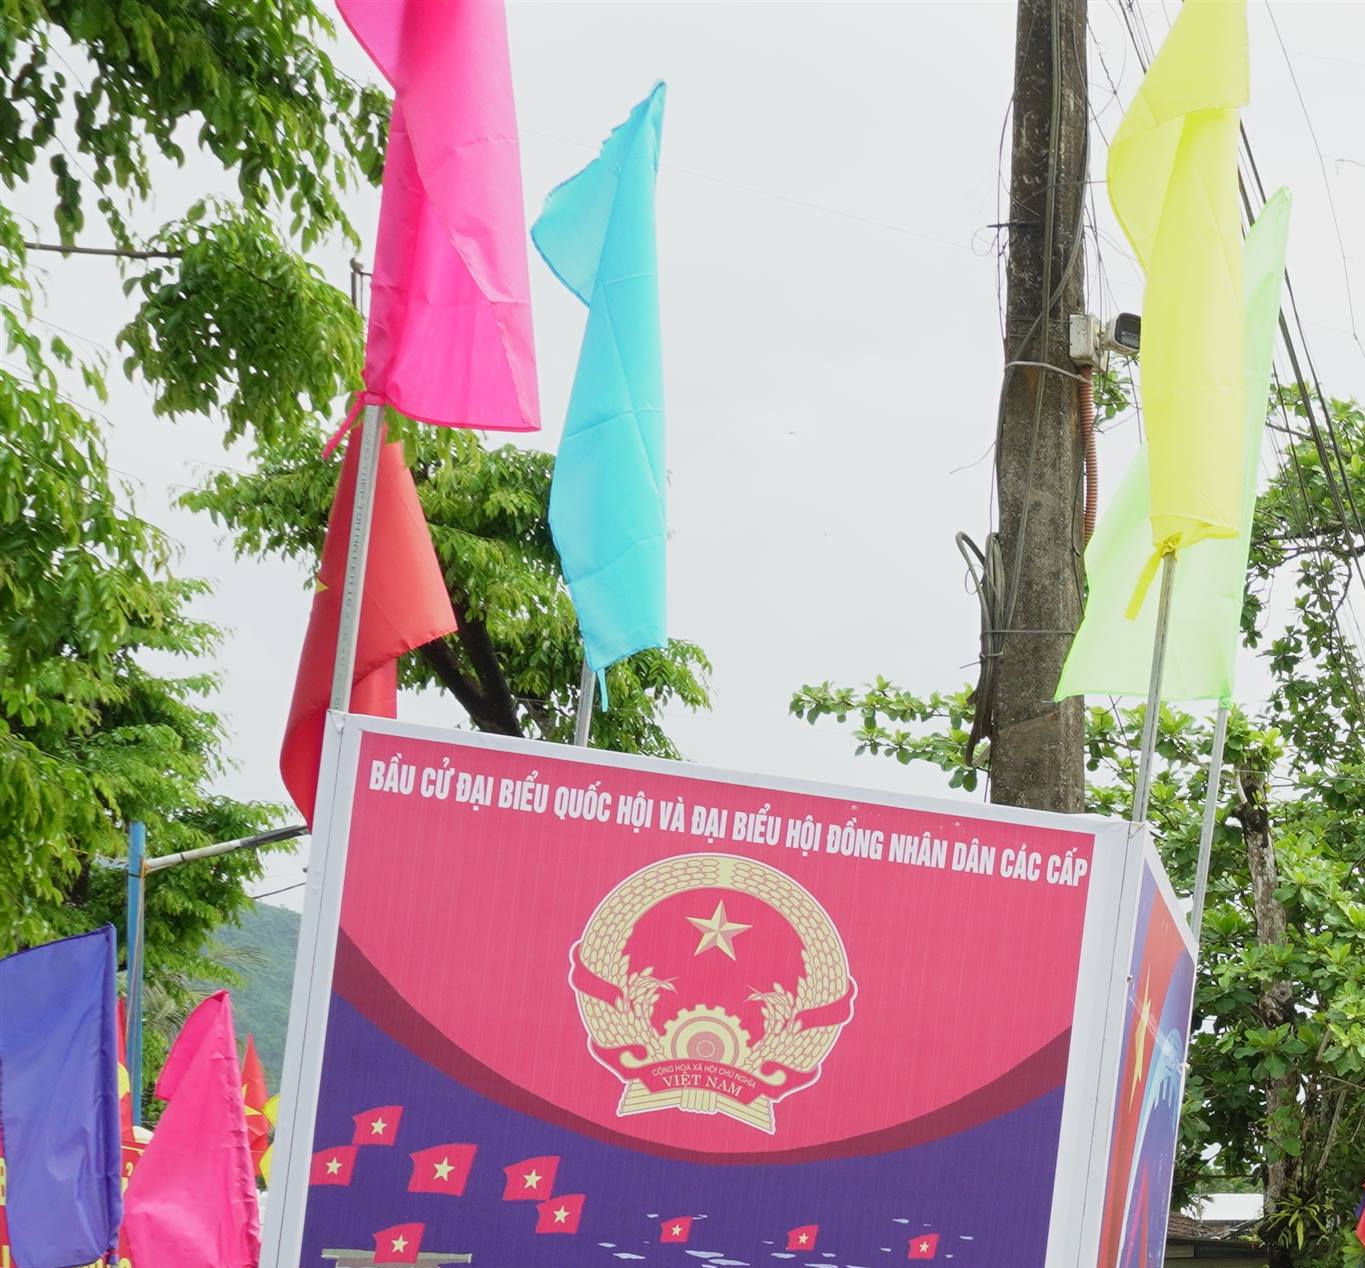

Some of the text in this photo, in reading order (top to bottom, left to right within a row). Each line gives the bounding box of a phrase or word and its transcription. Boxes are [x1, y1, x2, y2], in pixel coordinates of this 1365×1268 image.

[369, 752, 1088, 887] BẦU CỬ ĐẠI BIỂU QUỐC HỘI VÀ ĐẠI BIỂU HỘI ĐỒNG NHÂN DÂN CÁC CẤP
[662, 1072, 743, 1097] VIỆT NAM
